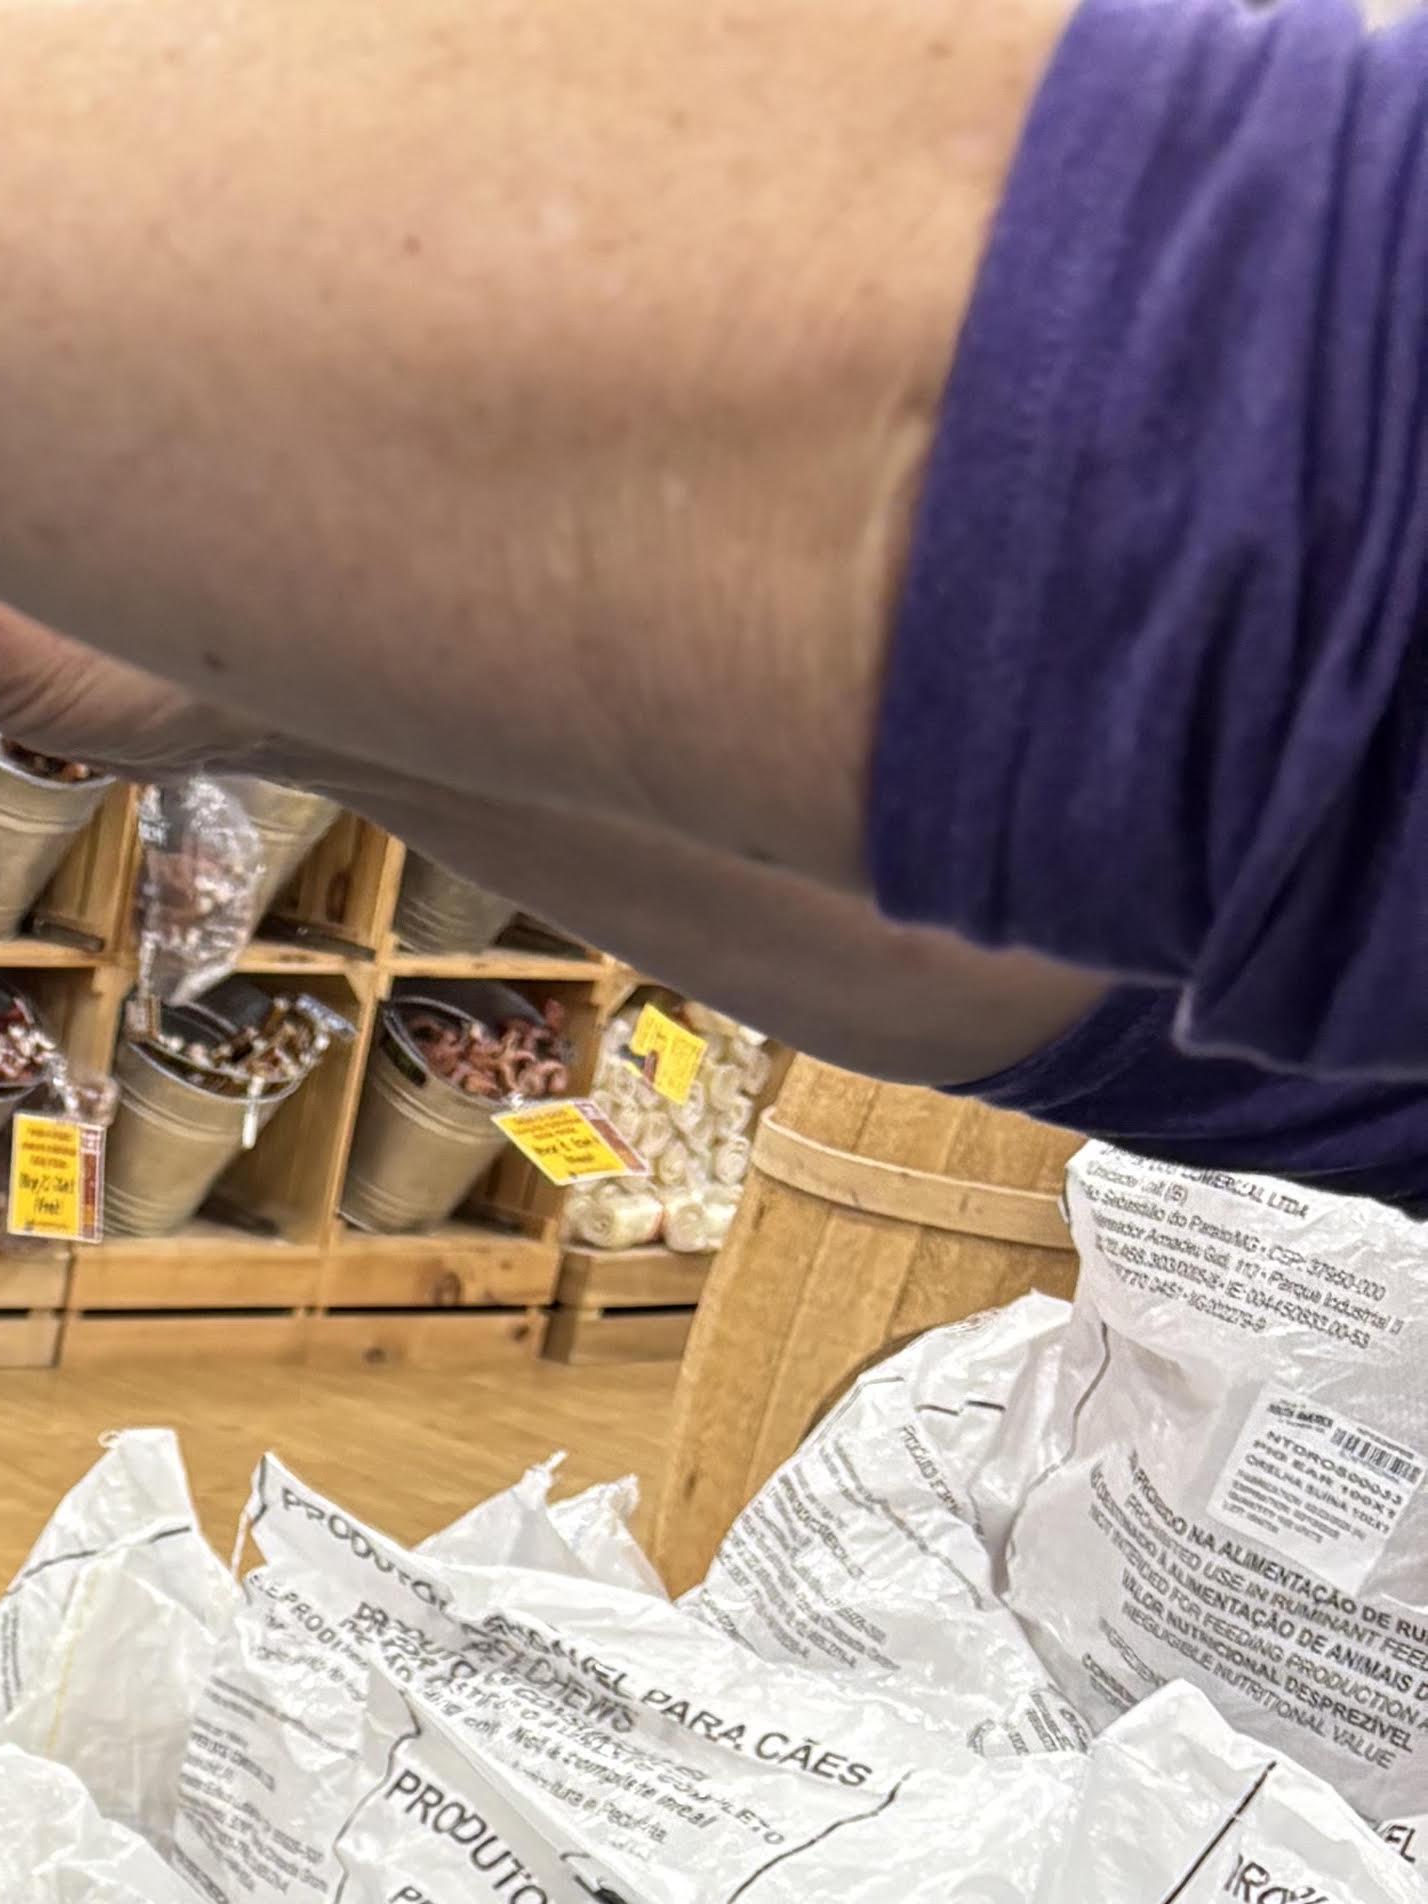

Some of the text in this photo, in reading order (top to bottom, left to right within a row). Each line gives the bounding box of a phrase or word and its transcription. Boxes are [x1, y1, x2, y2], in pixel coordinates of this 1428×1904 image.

[1163, 1563, 1413, 1694] ALIMENTAÇÃO DE ANIMAIS
[1191, 1525, 1215, 1551] NA
[1220, 1538, 1357, 1615] ALIMENTAÇÃO
[1361, 1605, 1391, 1630] DE
[1203, 1562, 1246, 1592] USE
[1247, 1581, 1270, 1602] IN
[1272, 1591, 1382, 1649] RUMINANT
[1166, 1611, 1282, 1686] NUTRICIONAL
[1284, 1678, 1413, 1753] DESPREZÍVEL
[1171, 1588, 1202, 1620] FOR
[1203, 1611, 1283, 1663] FEEDING
[1285, 1654, 1421, 1725] PRODUCTION
[642, 1688, 748, 1752] PARA
[754, 1730, 873, 1790] CÃES
[1213, 1663, 1326, 1735] NUTRITIONAL
[1332, 1723, 1397, 1770] VALUE
